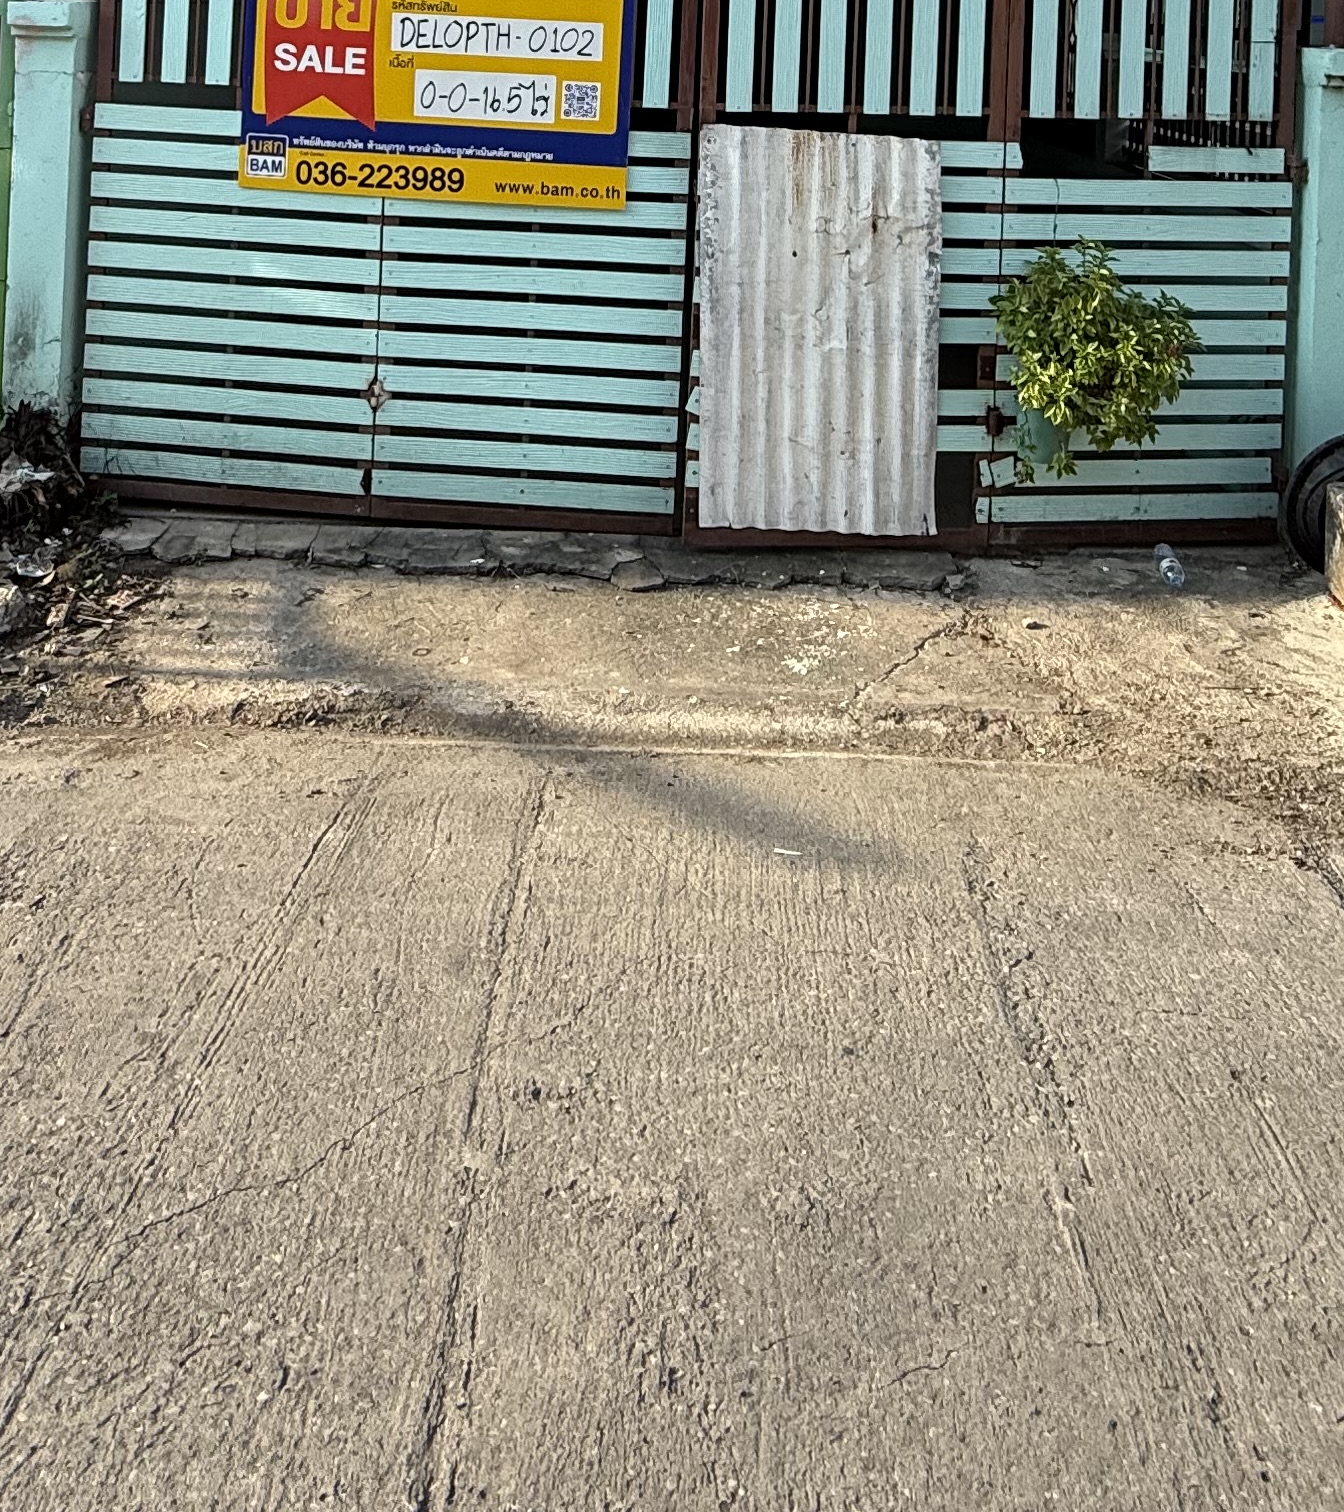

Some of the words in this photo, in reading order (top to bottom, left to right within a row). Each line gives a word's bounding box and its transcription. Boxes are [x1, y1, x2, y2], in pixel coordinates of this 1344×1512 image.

[391, 0, 458, 13] รหัสทรัพย์สิน
[273, 42, 367, 76] SALE
[389, 53, 415, 69] เนื้อที่
[250, 138, 284, 155] บสก
[249, 157, 283, 174] BAM
[295, 159, 465, 193] 036-223989
[494, 180, 621, 200] www.bam.co.th
